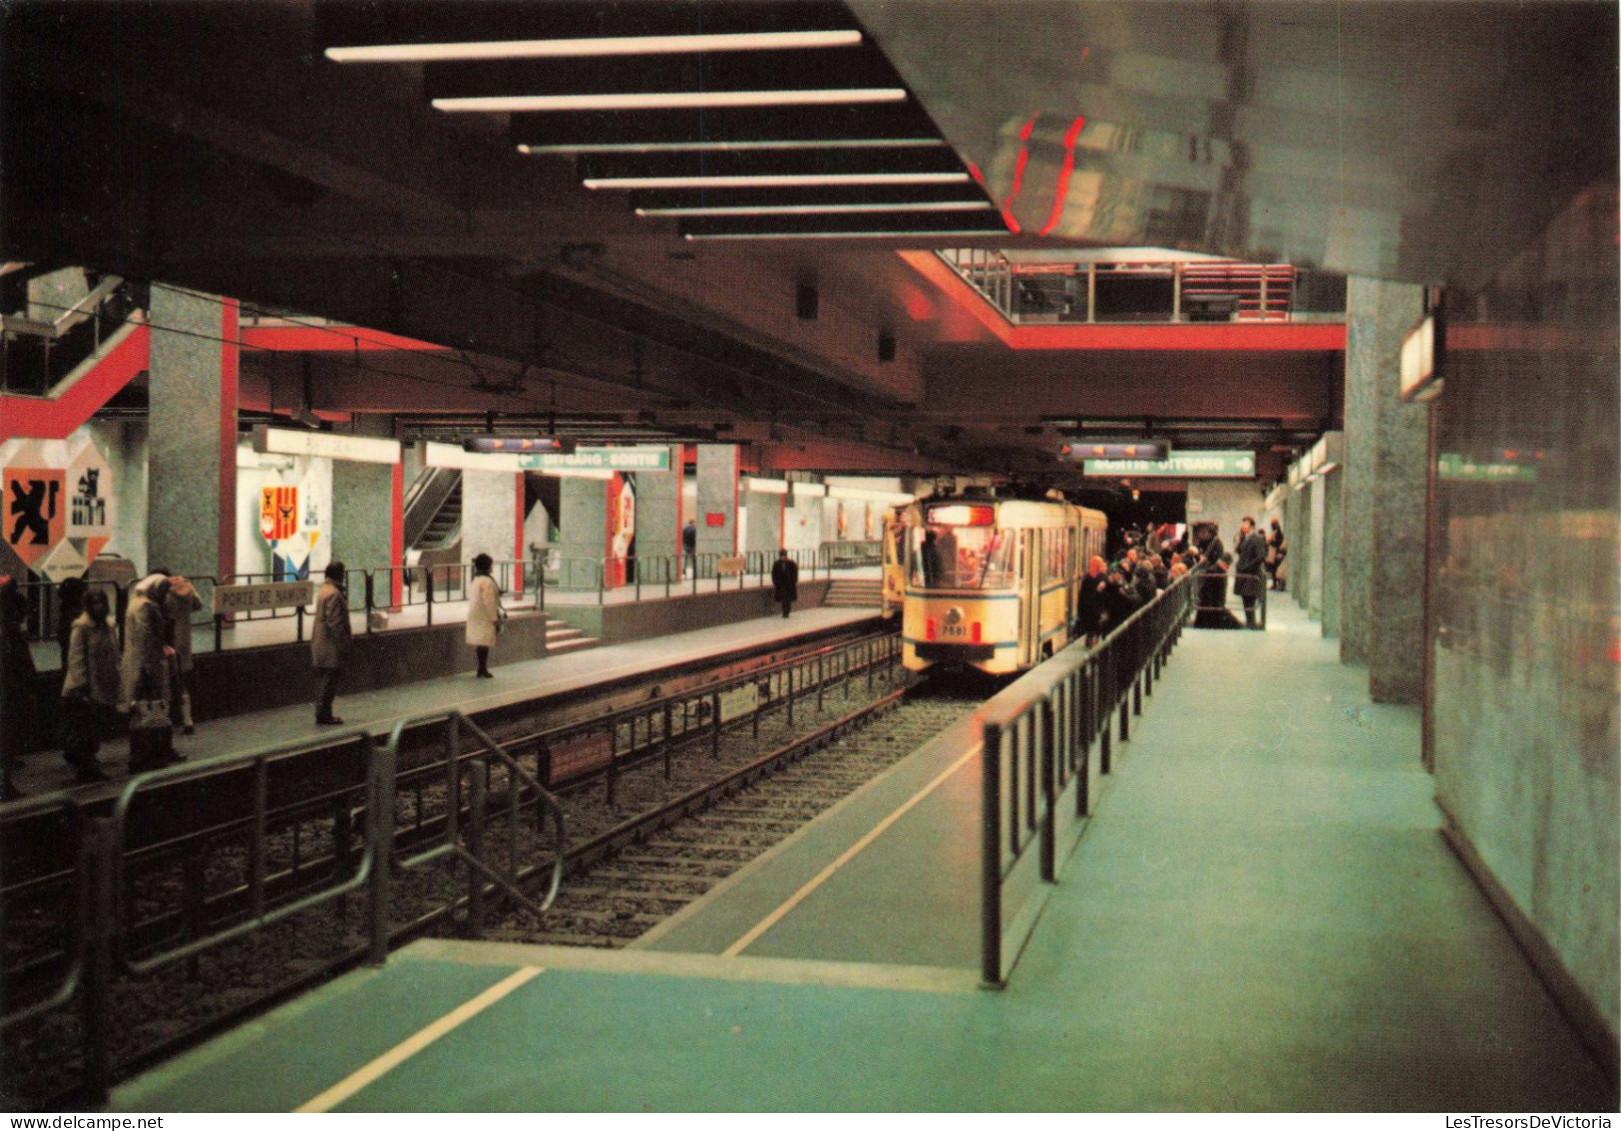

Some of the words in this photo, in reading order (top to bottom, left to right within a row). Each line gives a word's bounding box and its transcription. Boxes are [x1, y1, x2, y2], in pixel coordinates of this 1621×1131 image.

[610, 453, 659, 466] SORTIE
[1158, 457, 1225, 471] UITGANG
[222, 591, 255, 606] PORTE
[259, 589, 271, 604] DE
[275, 587, 308, 602] NAMUR
